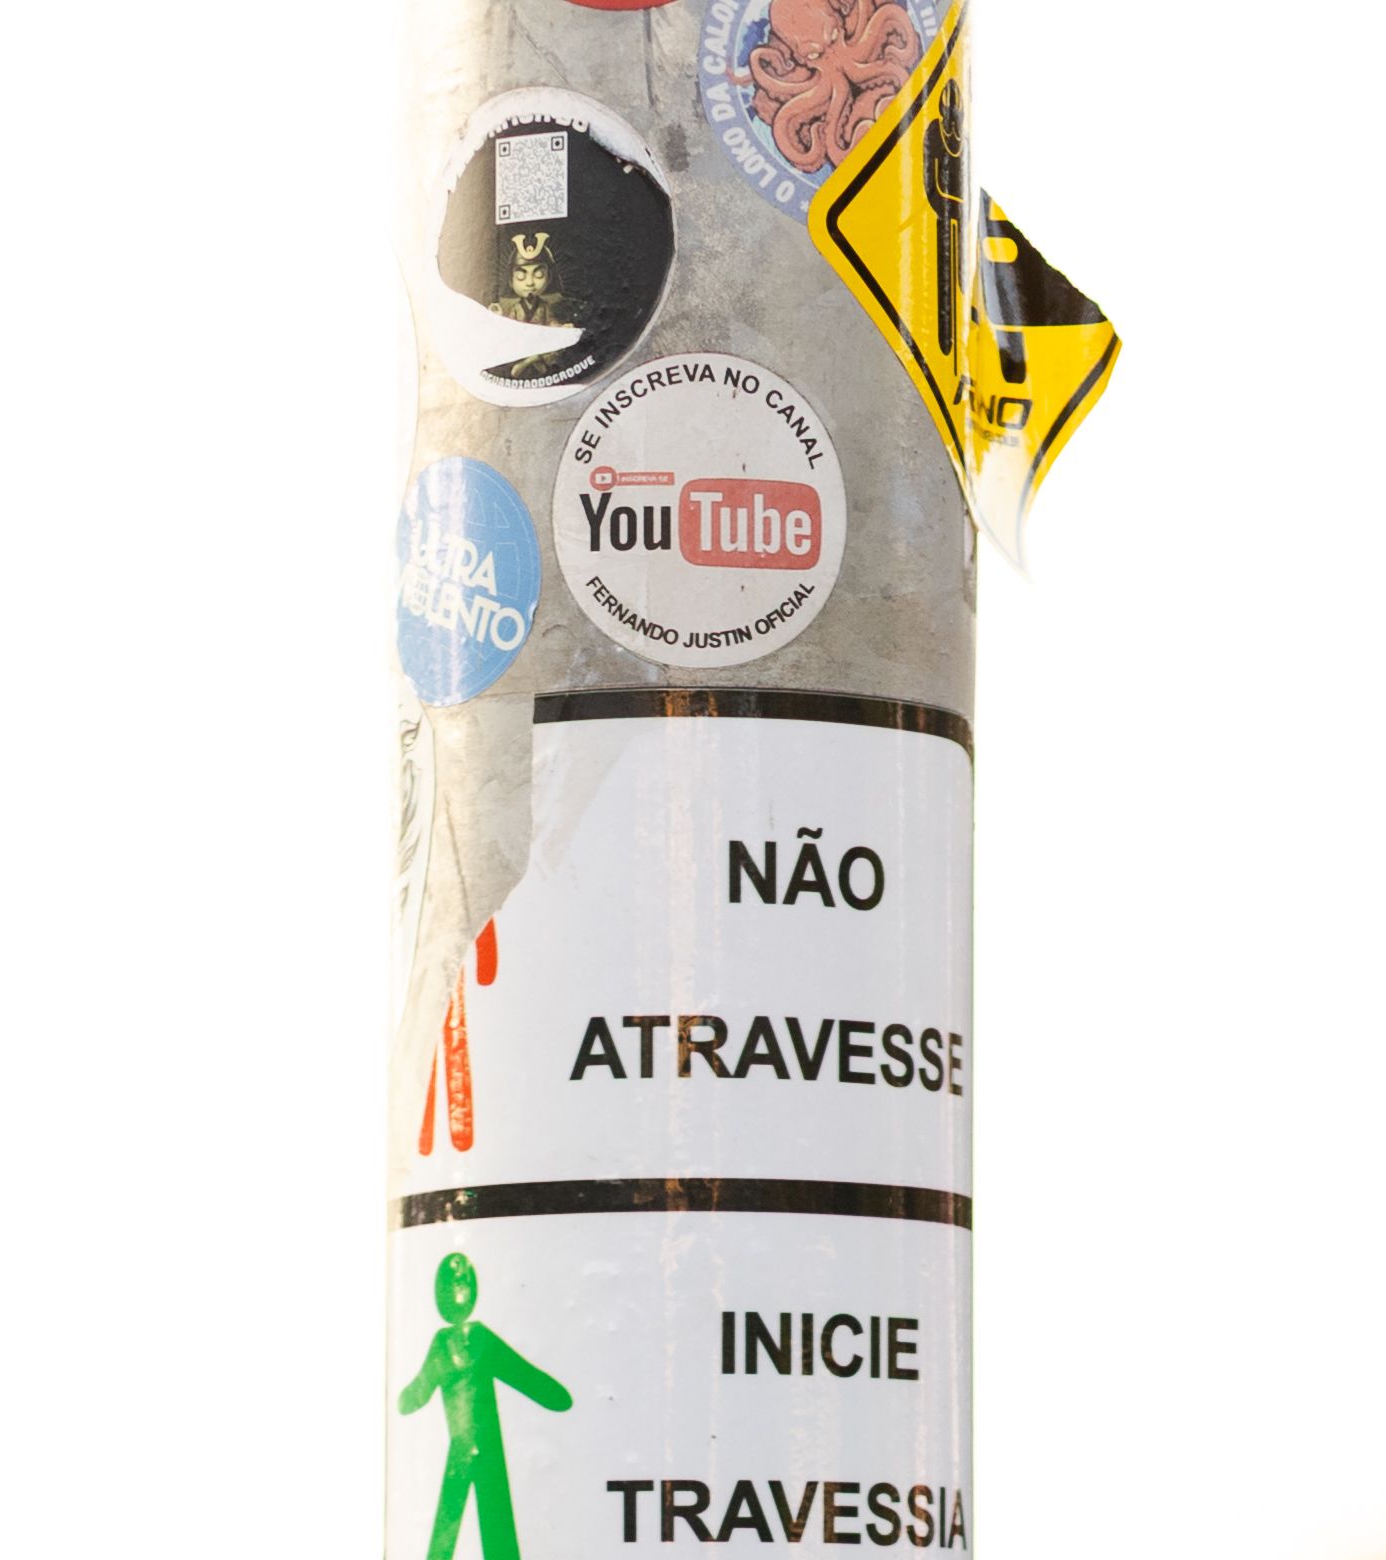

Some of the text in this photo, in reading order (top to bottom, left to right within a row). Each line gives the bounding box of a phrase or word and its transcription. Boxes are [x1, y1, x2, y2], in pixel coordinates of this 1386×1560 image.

[706, 82, 736, 122] DA
[723, 126, 777, 187] LOKO
[775, 182, 795, 203] O
[574, 363, 824, 471] SE INSCREVA NO CANAL
[586, 576, 816, 649] FERNANDO JUSTIN OFICIAL
[729, 827, 885, 911] NÃO
[569, 1015, 963, 1097] ATRAVESSE
[721, 1311, 920, 1381] INICIE
[606, 1480, 968, 1551] TRAVESSIA
